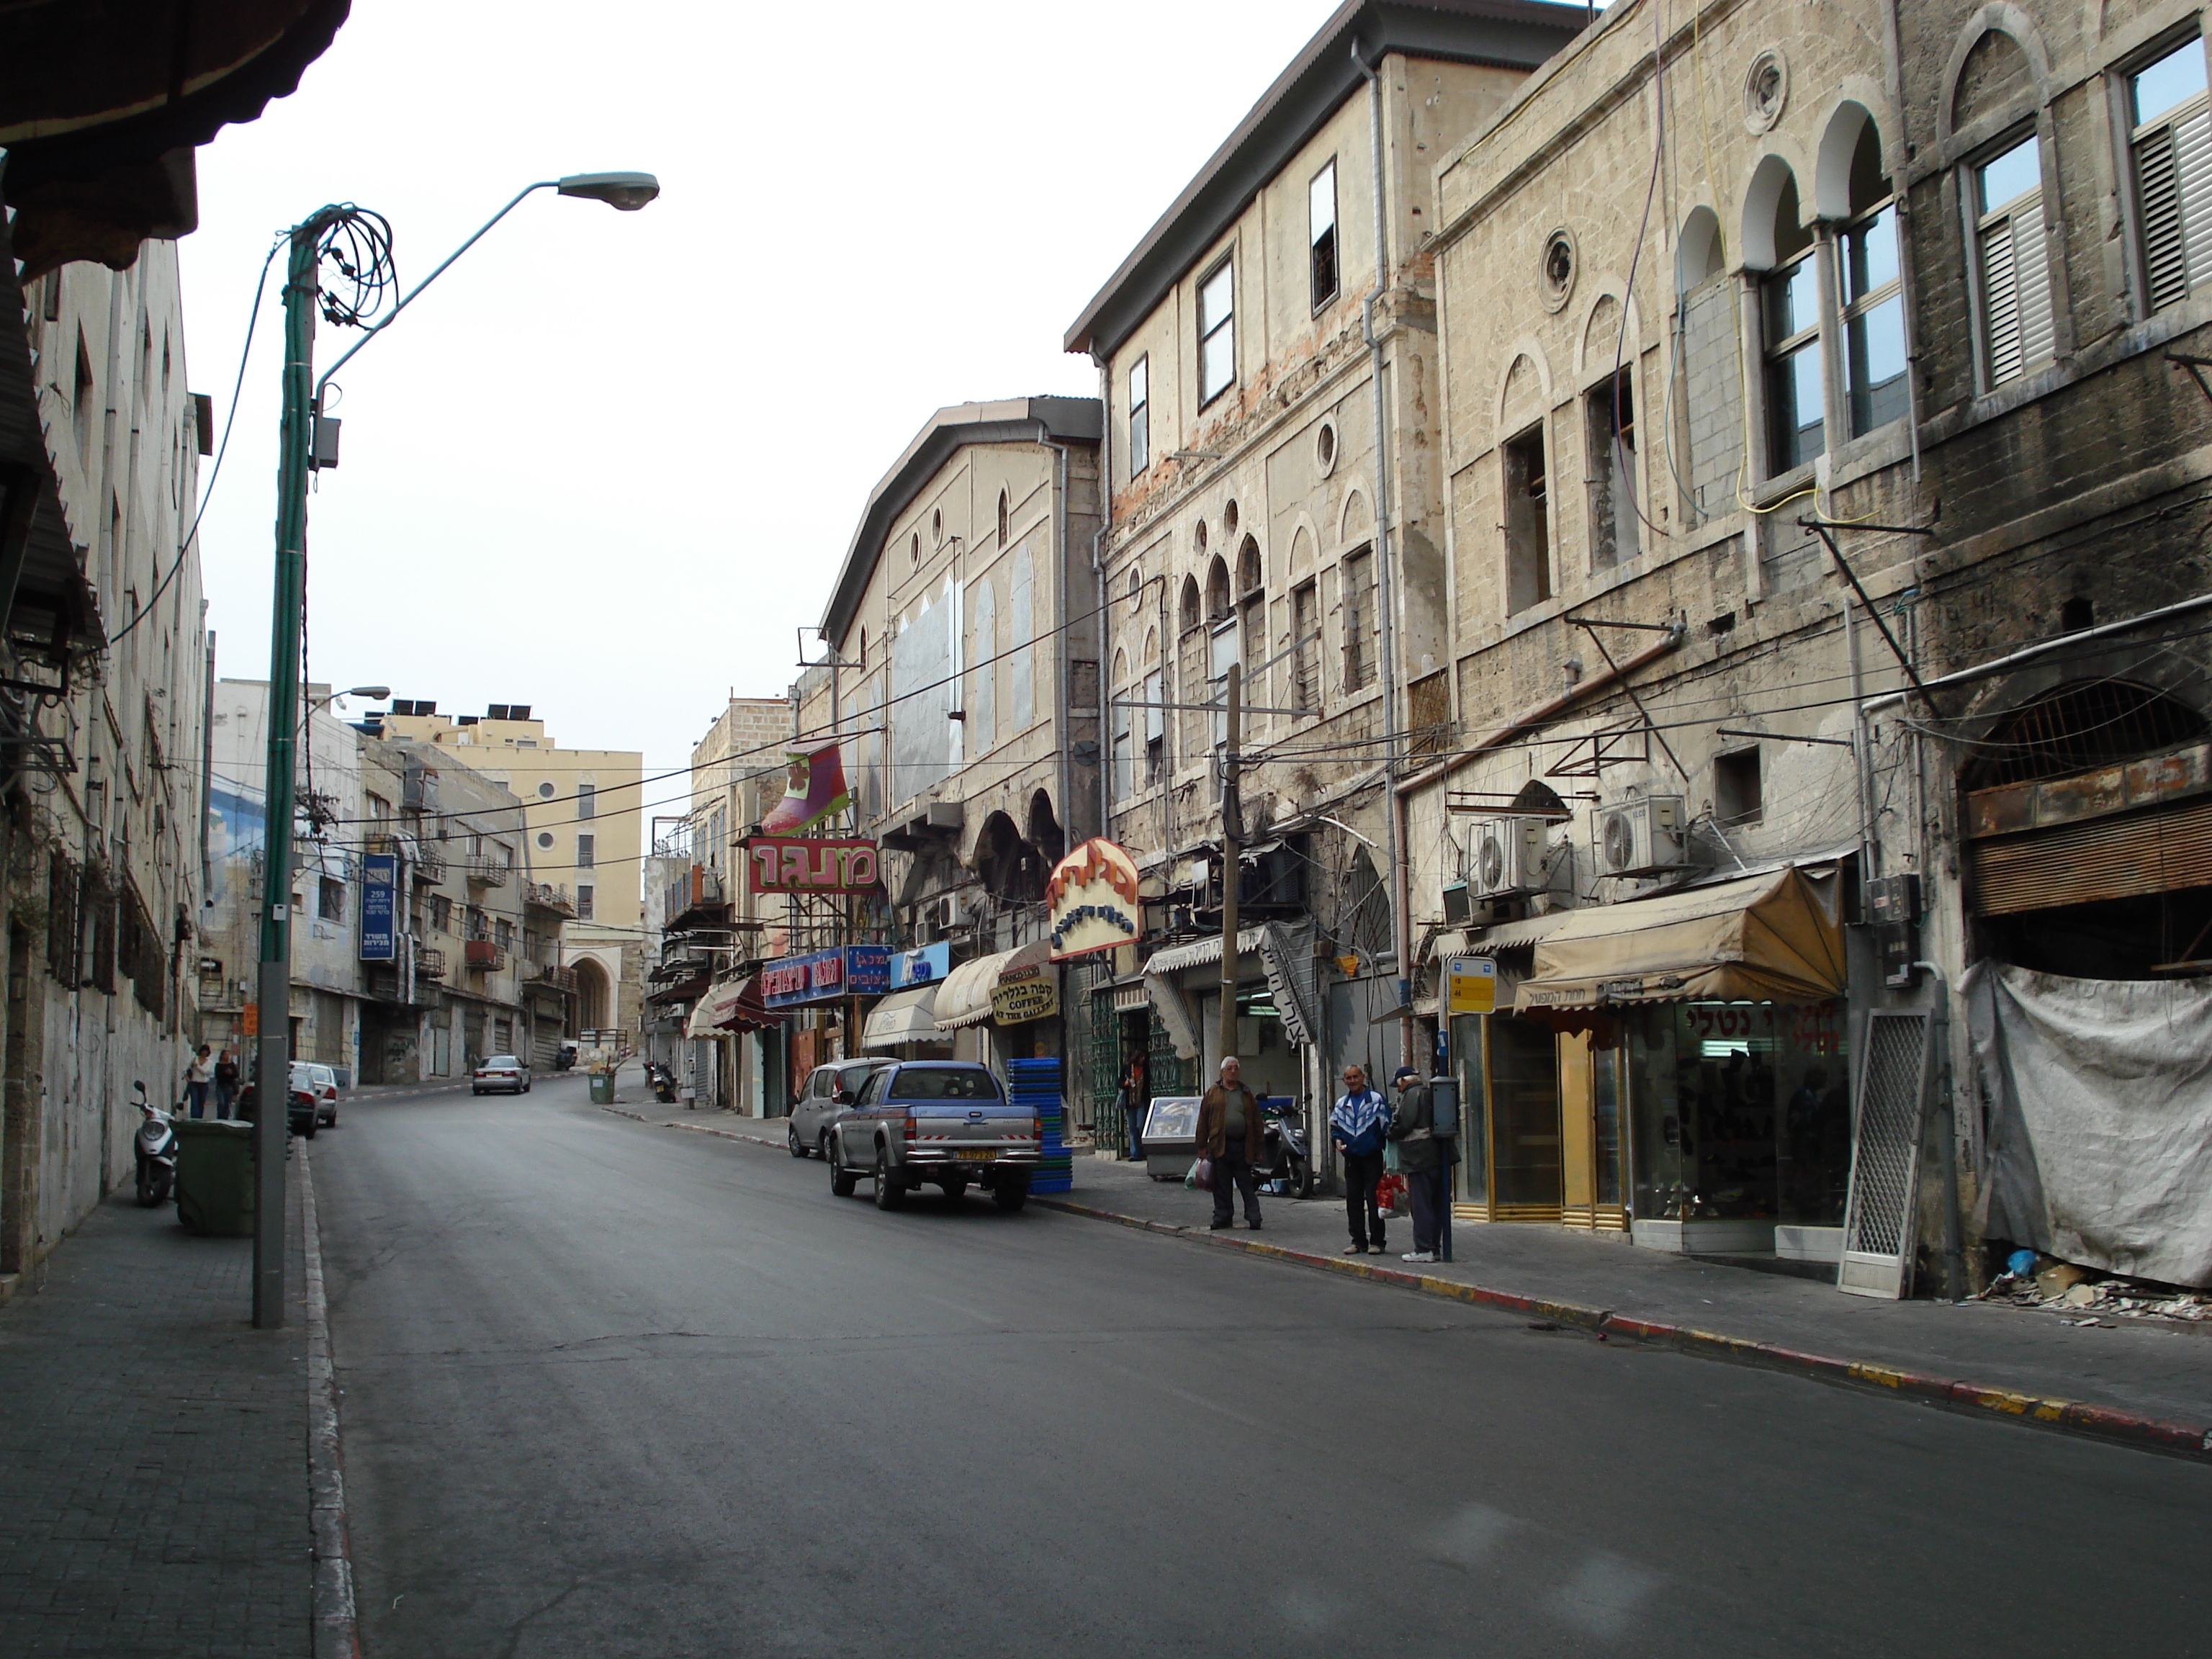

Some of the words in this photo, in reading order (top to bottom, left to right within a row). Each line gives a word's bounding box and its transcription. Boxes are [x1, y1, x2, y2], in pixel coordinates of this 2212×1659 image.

[752, 845, 877, 889] מנגו
[992, 986, 1028, 1007] בגלריה
[1030, 984, 1052, 997] קפה
[1529, 990, 1561, 1005] המפעל
[1010, 996, 1043, 1010] COFFEE
[1023, 997, 1054, 1018] GALLERY
[1686, 1005, 1750, 1037] נטלי
